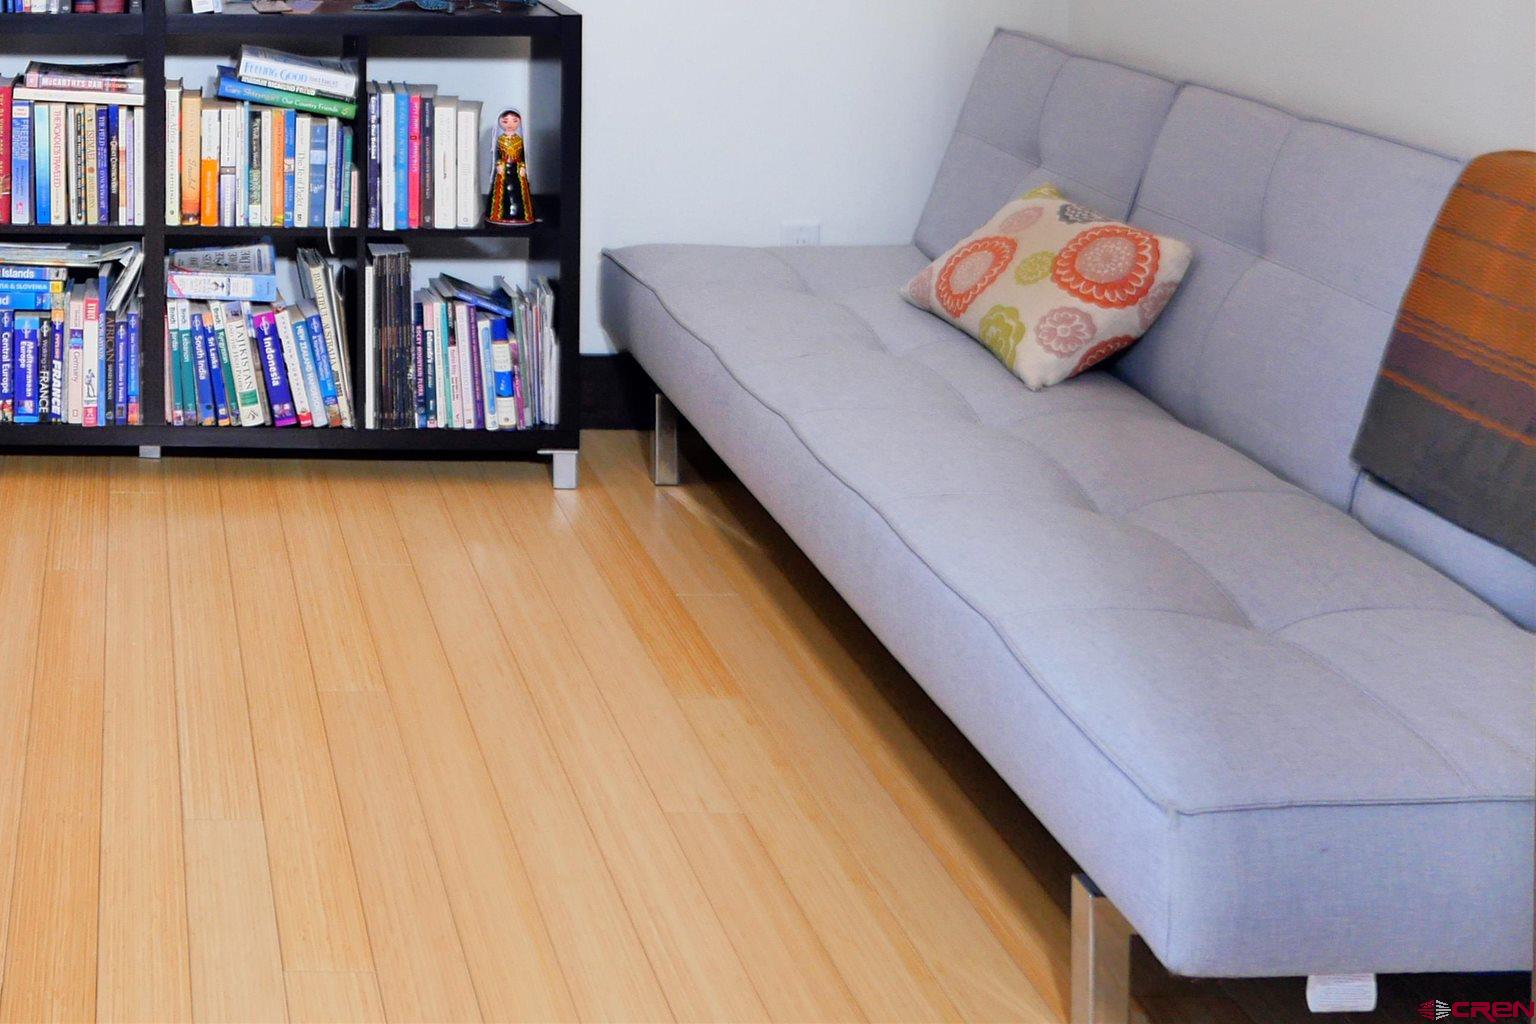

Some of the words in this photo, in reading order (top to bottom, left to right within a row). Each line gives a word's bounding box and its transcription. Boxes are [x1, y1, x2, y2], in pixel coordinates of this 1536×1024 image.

[294, 99, 317, 109] Country
[318, 103, 339, 112] Friends
[1, 268, 35, 280] Islands
[296, 325, 306, 341] NEW
[312, 273, 328, 318] BEAUTIFUL
[323, 323, 336, 366] AUSTRALIA
[40, 339, 48, 364] Walking
[106, 317, 114, 362] AFRICAN
[170, 332, 178, 351] Jordan
[182, 333, 190, 363] Lebanon
[194, 335, 204, 359] South
[208, 337, 216, 348] Sri
[217, 332, 228, 364] Kyrgyzstan
[71, 351, 80, 383] Germany
[198, 361, 207, 380] India
[209, 348, 218, 369] Lanka
[263, 337, 280, 386] Indonesia
[300, 342, 313, 372] ZEALAND
[1, 364, 9, 393] Europe
[40, 371, 49, 413] FRANCE
[52, 360, 61, 415] FRANCE
[306, 373, 320, 412] HANDBOOK
